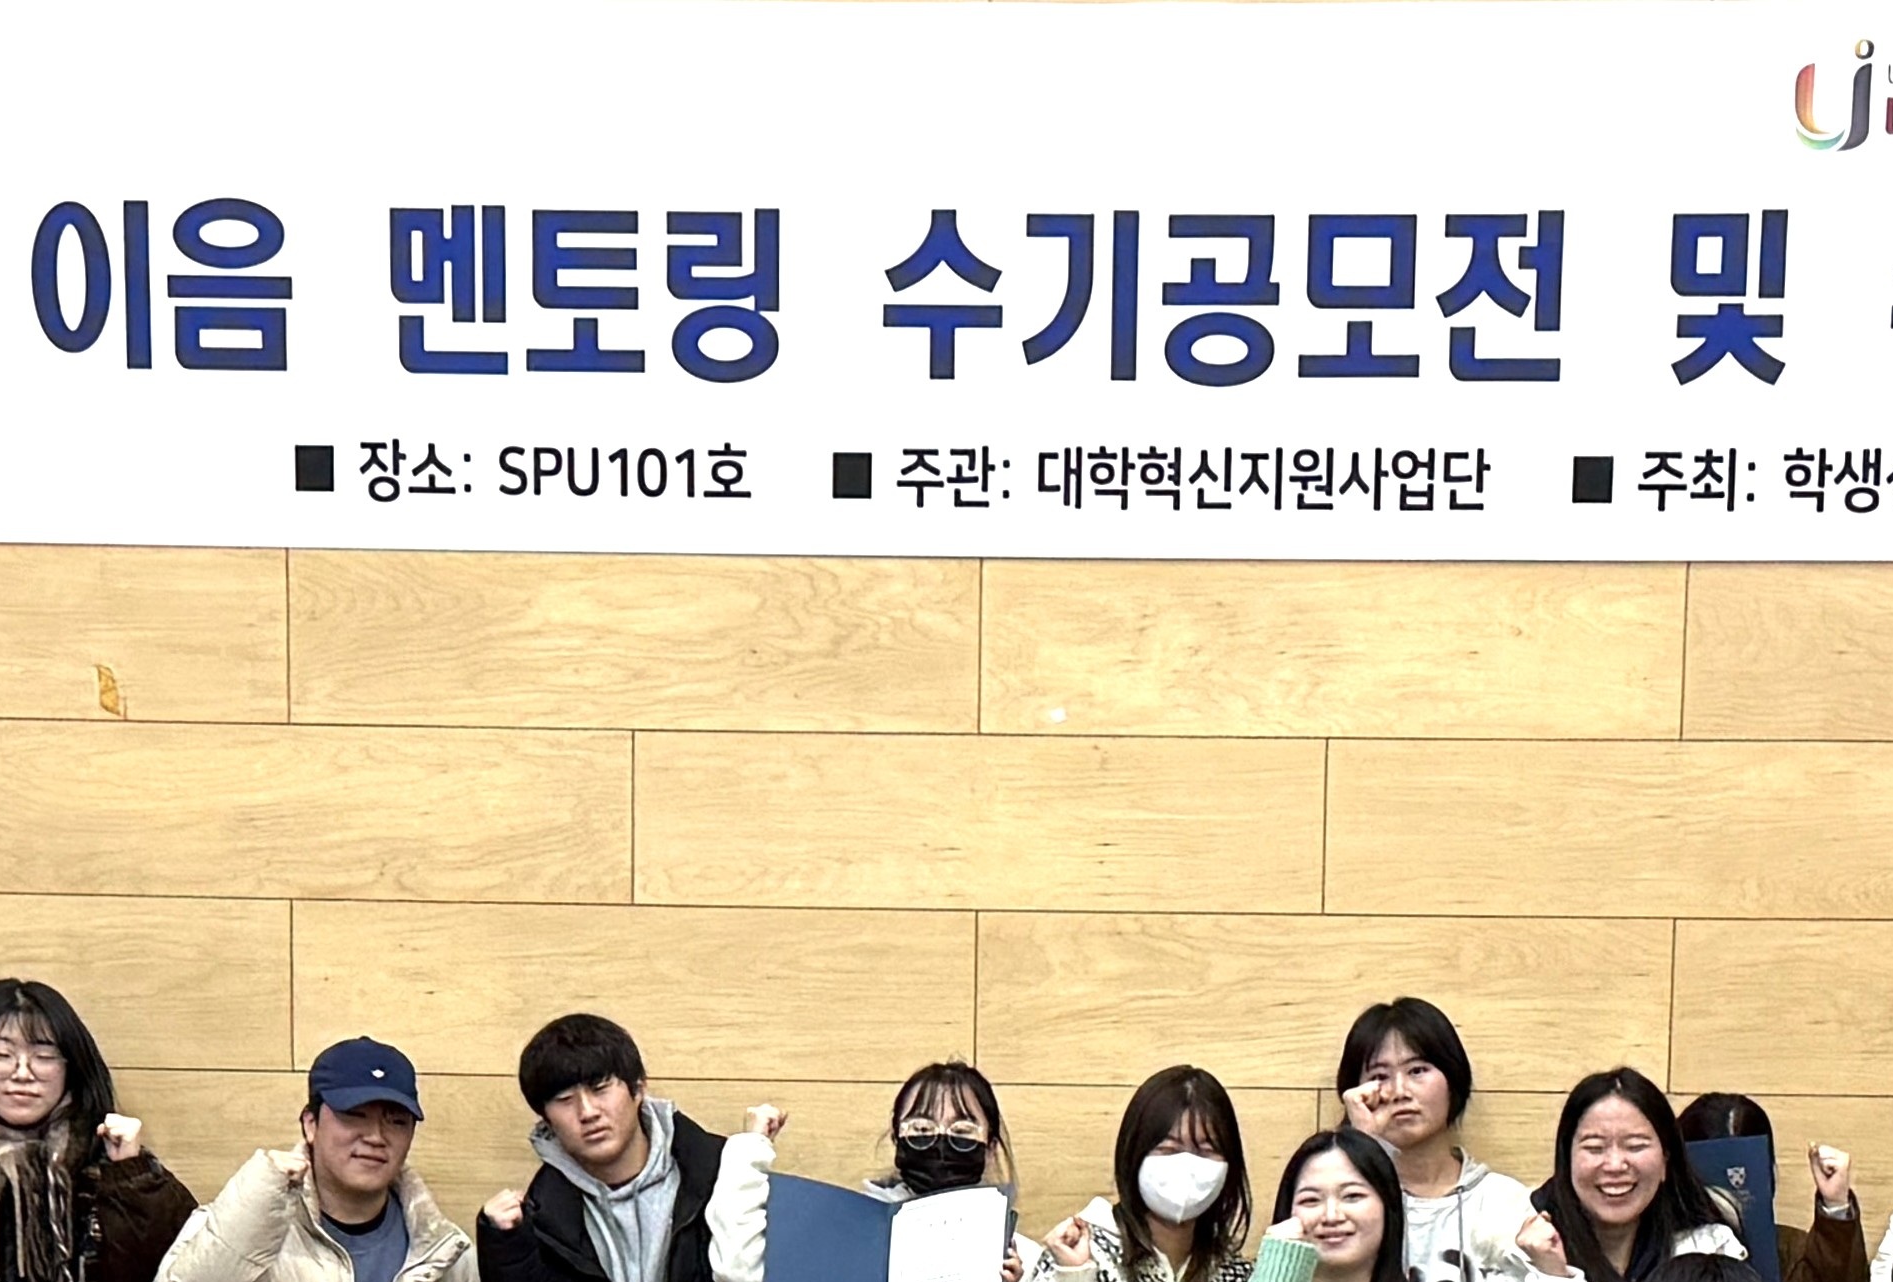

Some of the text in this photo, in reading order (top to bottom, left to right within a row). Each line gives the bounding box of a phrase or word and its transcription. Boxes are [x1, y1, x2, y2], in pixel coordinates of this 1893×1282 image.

[30, 197, 293, 372] 이음
[389, 204, 781, 384] 멘토링
[882, 208, 1566, 388] 수기공모전
[1669, 208, 1789, 386] 및
[359, 438, 752, 503] 장소: SPU101호
[896, 446, 1492, 512] 주관: 대학혁신지원사업단
[1637, 447, 1756, 513] 주최:
